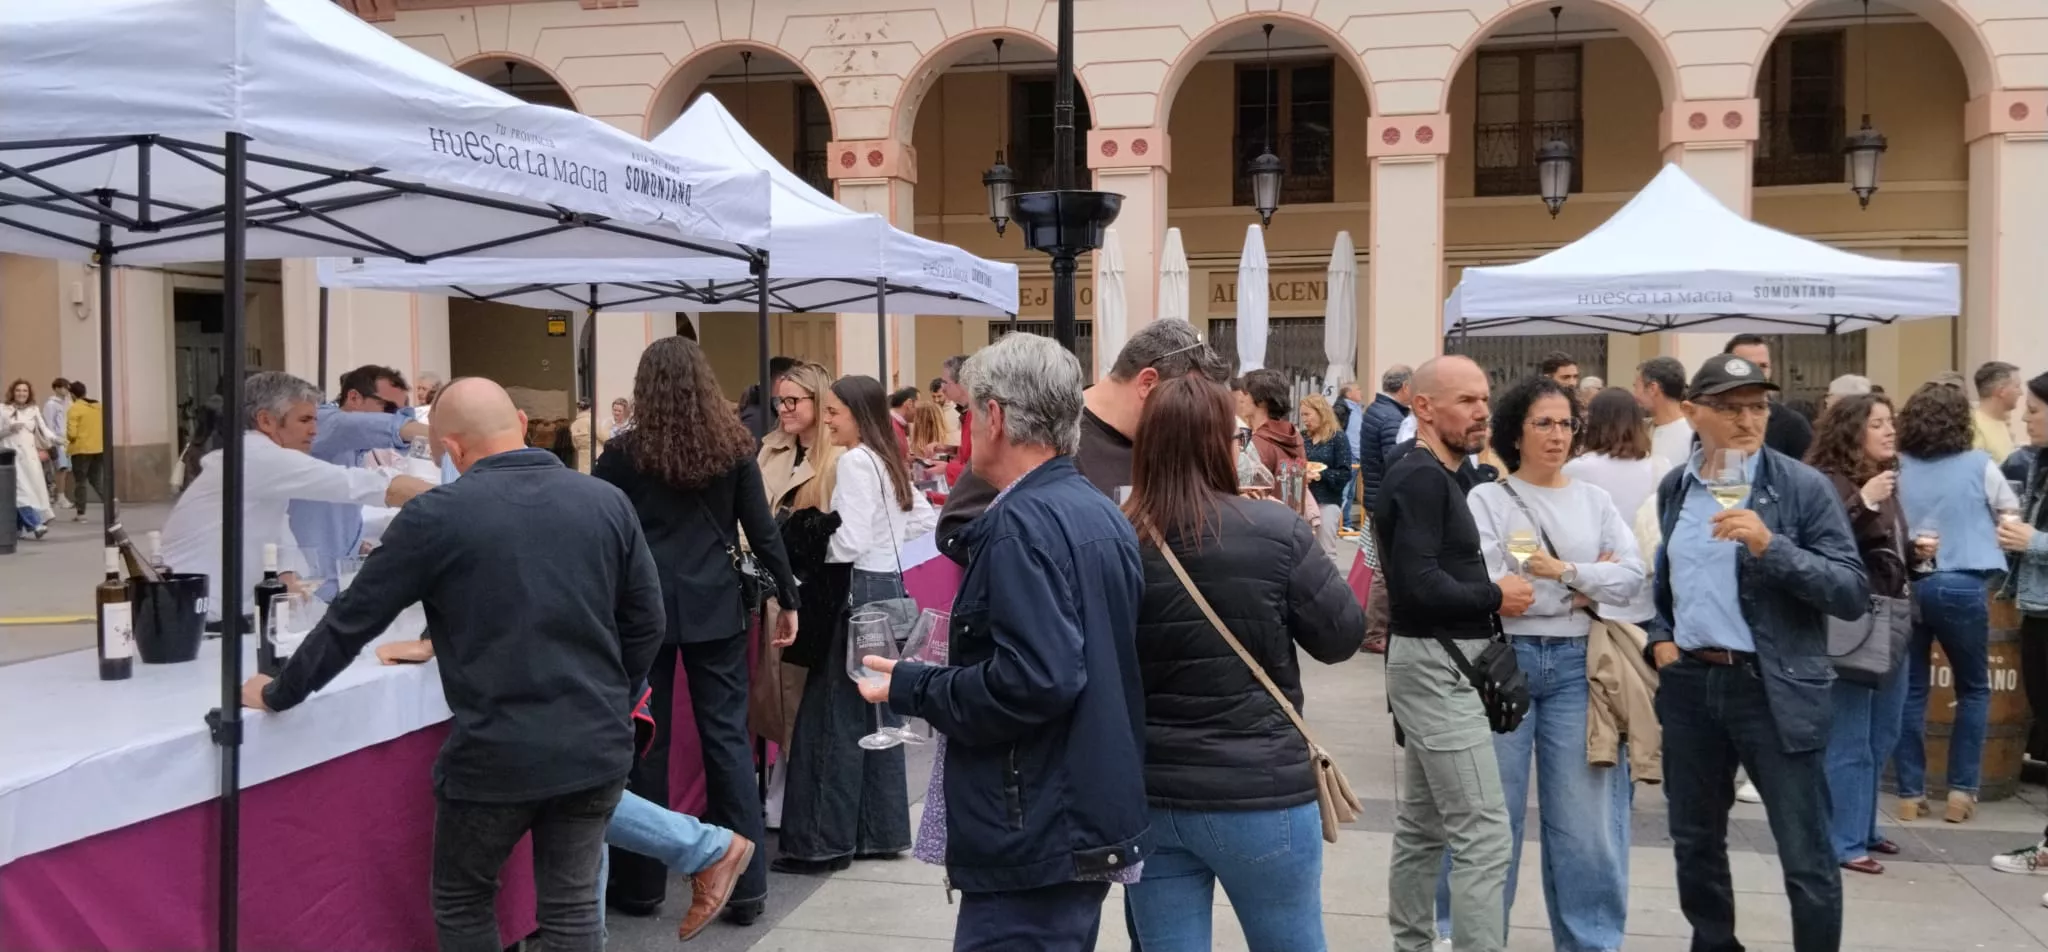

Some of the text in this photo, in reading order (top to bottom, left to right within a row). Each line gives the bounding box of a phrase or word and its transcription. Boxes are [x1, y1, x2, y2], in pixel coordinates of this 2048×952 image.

[496, 123, 507, 136] TU
[625, 164, 692, 207] SOMONTANO
[1753, 285, 1836, 299] SOMONTANO
